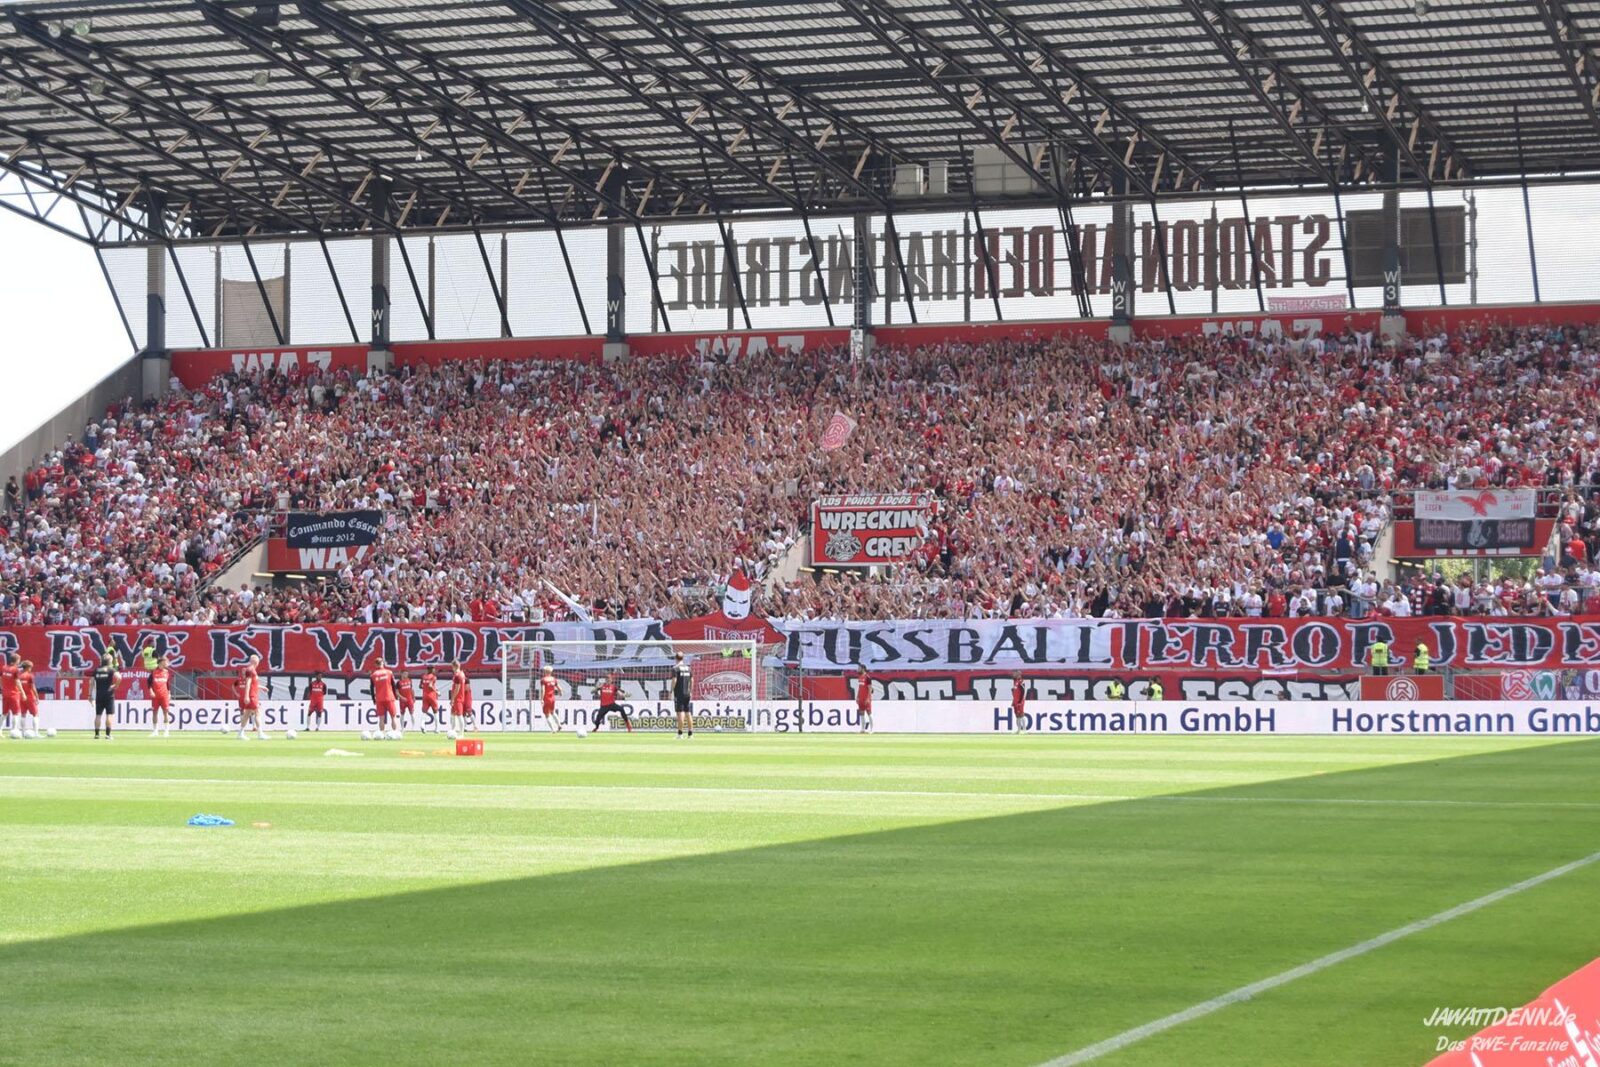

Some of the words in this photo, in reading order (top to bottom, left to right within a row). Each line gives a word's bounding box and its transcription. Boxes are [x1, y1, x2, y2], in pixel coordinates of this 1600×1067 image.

[1384, 271, 1398, 283] W
[1113, 281, 1126, 293] W
[1386, 286, 1396, 300] 3
[607, 300, 619, 312] W
[1115, 295, 1125, 310] 2
[1269, 298, 1345, 311] STRMKASTEN
[371, 309, 383, 320] W
[610, 314, 616, 328] 1
[374, 322, 380, 336] 1
[231, 351, 332, 376] WAZ
[289, 518, 346, 538] Commando
[348, 517, 378, 535] Essen
[311, 534, 334, 544] Since
[335, 532, 356, 543] 2012
[46, 627, 189, 671] RWE
[208, 624, 302, 671] IST
[306, 626, 566, 671] WIEDER
[120, 670, 151, 679] ralt-Ultr
[117, 702, 153, 724] Ihr
[168, 703, 288, 730] Speziast
[300, 703, 328, 724] in
[609, 716, 747, 729] TEAMSPORBEDARF.DE
[993, 707, 1167, 732] Horstmann
[1180, 707, 1276, 732] GmbH
[1332, 707, 1515, 732] Horstmann
[1528, 707, 1600, 732] Gmb
